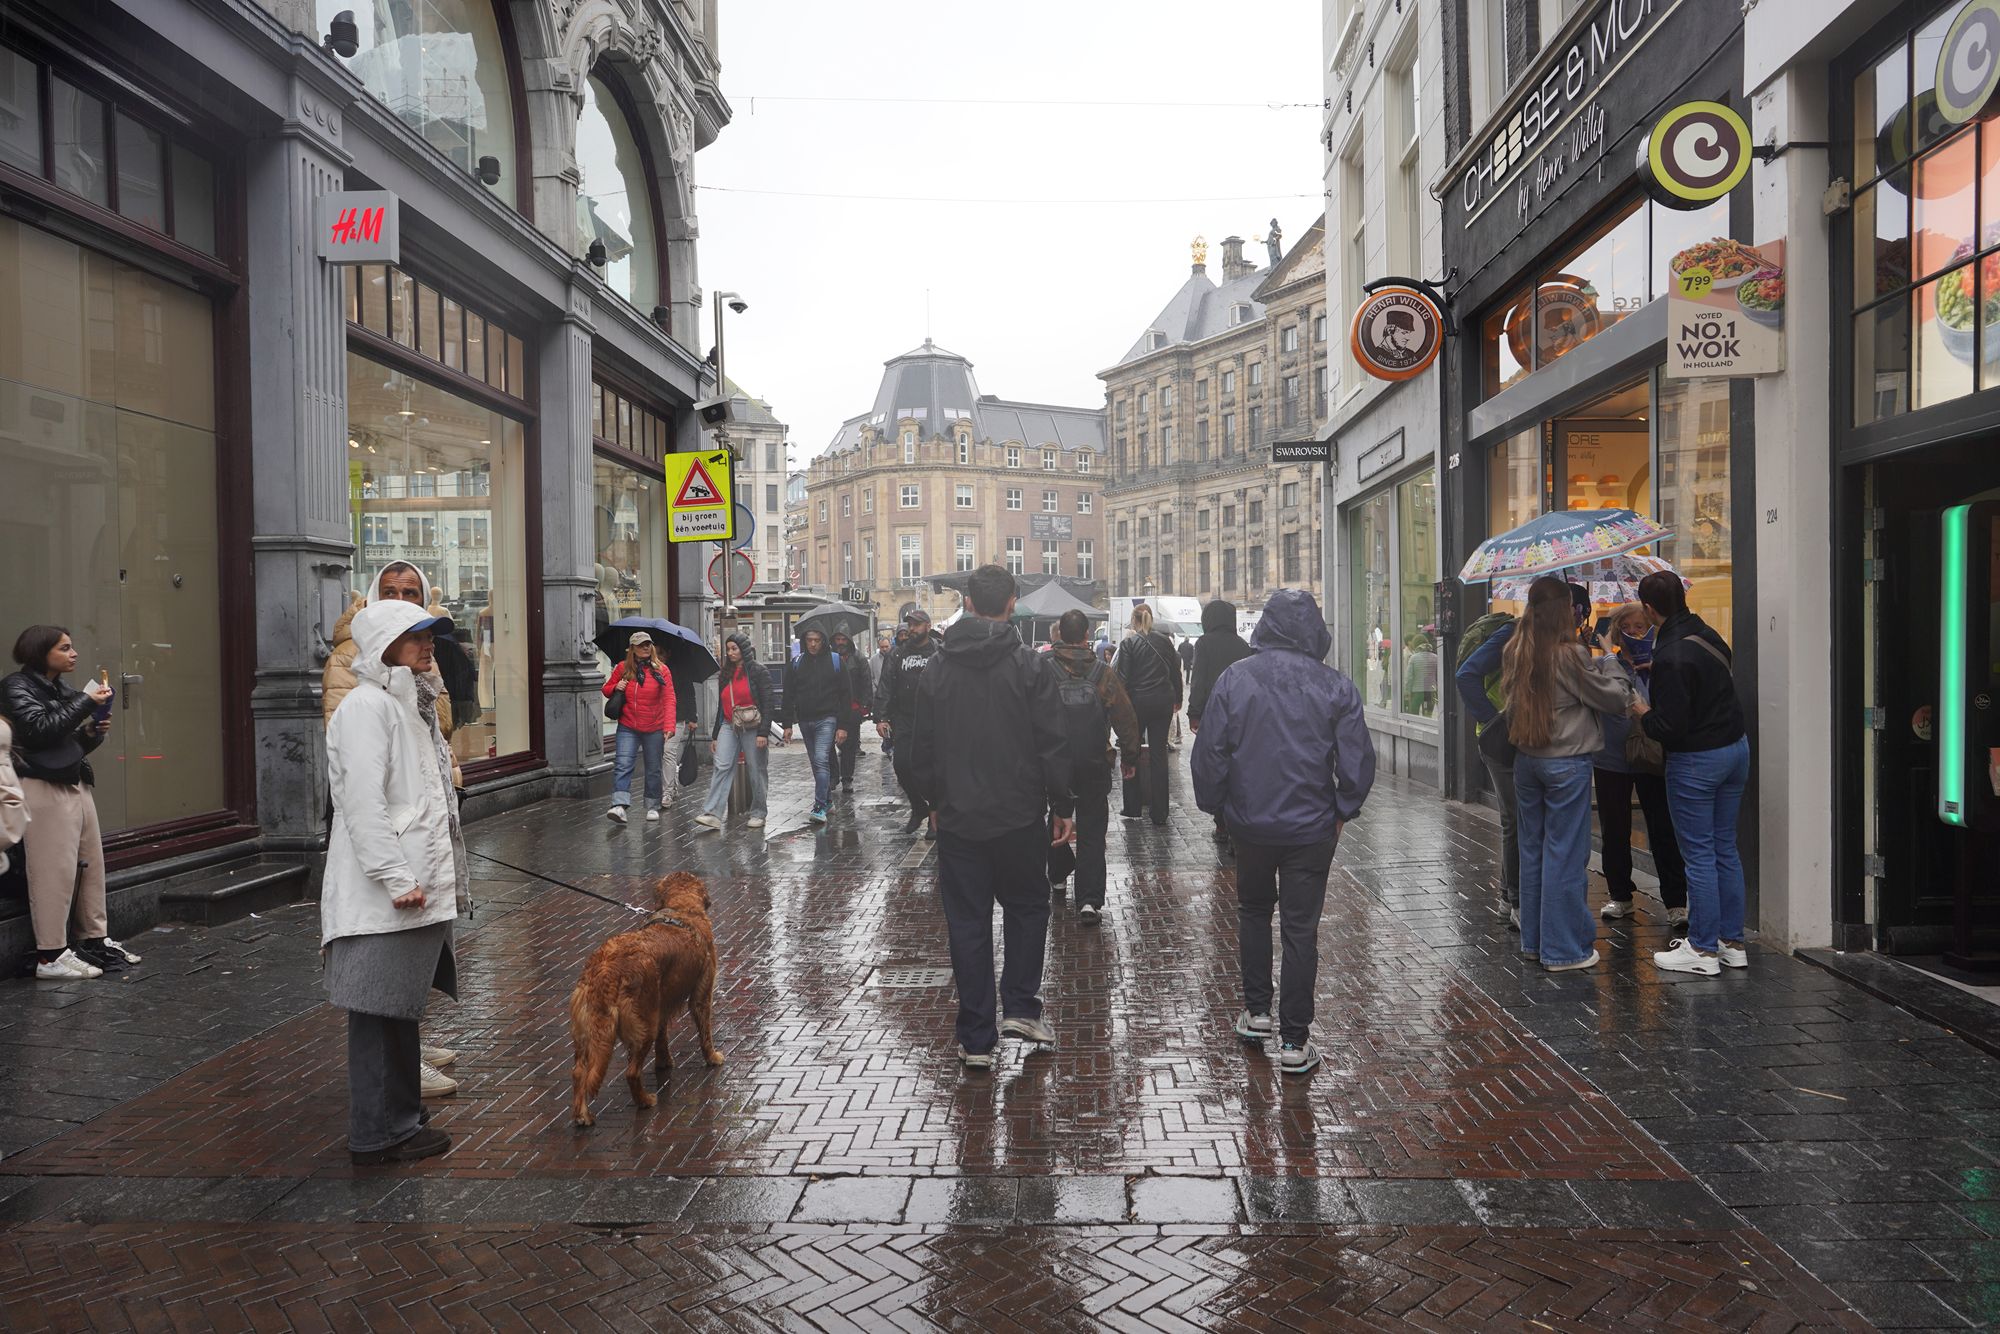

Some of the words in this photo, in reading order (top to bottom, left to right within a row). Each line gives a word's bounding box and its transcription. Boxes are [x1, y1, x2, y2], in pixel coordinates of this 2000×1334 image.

[1566, 45, 1585, 101] &
[1591, 0, 1652, 76] MO
[1518, 178, 1530, 225] by
[1536, 143, 1564, 201] Henri
[1572, 101, 1605, 183] Willig
[331, 207, 385, 245] H&M
[1366, 296, 1396, 320] HENRI
[1400, 296, 1431, 320] WILLIG
[1682, 321, 1735, 341] NO.1
[1676, 340, 1741, 360] WOK
[1376, 355, 1397, 366] SINCE
[1400, 355, 1418, 366] 1974
[1694, 361, 1733, 369] HOLLAND
[1568, 434, 1600, 446] ORE
[1276, 447, 1327, 457] SWAROVSKI
[682, 514, 692, 522] bij
[695, 513, 717, 521] groen
[1766, 507, 1778, 525] 224
[692, 522, 725, 532] voertuig
[1543, 522, 1586, 536] Amsterdam
[850, 588, 861, 600] 16
